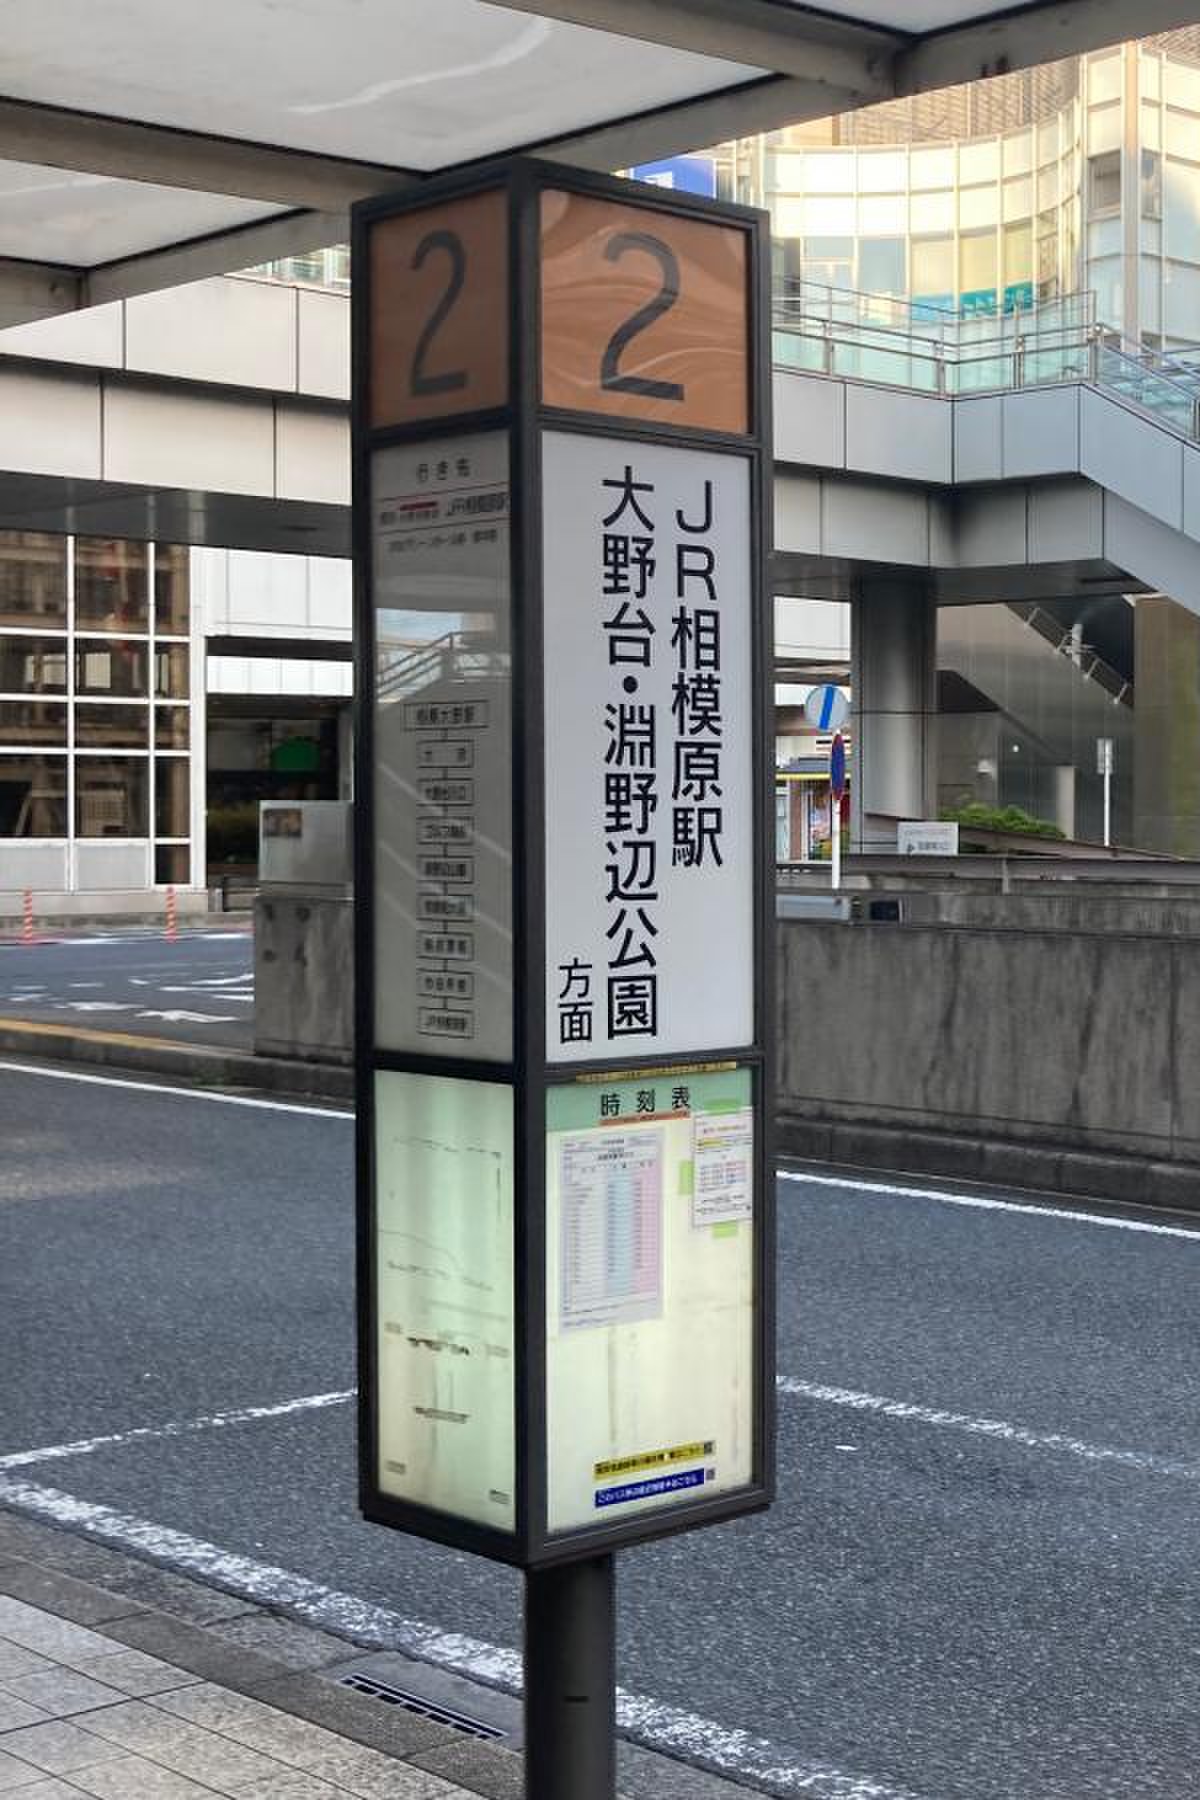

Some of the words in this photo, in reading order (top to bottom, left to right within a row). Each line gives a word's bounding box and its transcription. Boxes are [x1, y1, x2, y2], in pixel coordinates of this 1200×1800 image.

[409, 229, 470, 396] 2
[601, 231, 685, 401] 2
[602, 464, 658, 1041] 大野台・淵野辺公園
[671, 479, 724, 868] JR相模原駅
[557, 957, 594, 1044] 方面
[601, 1085, 692, 1117] 時刻表
